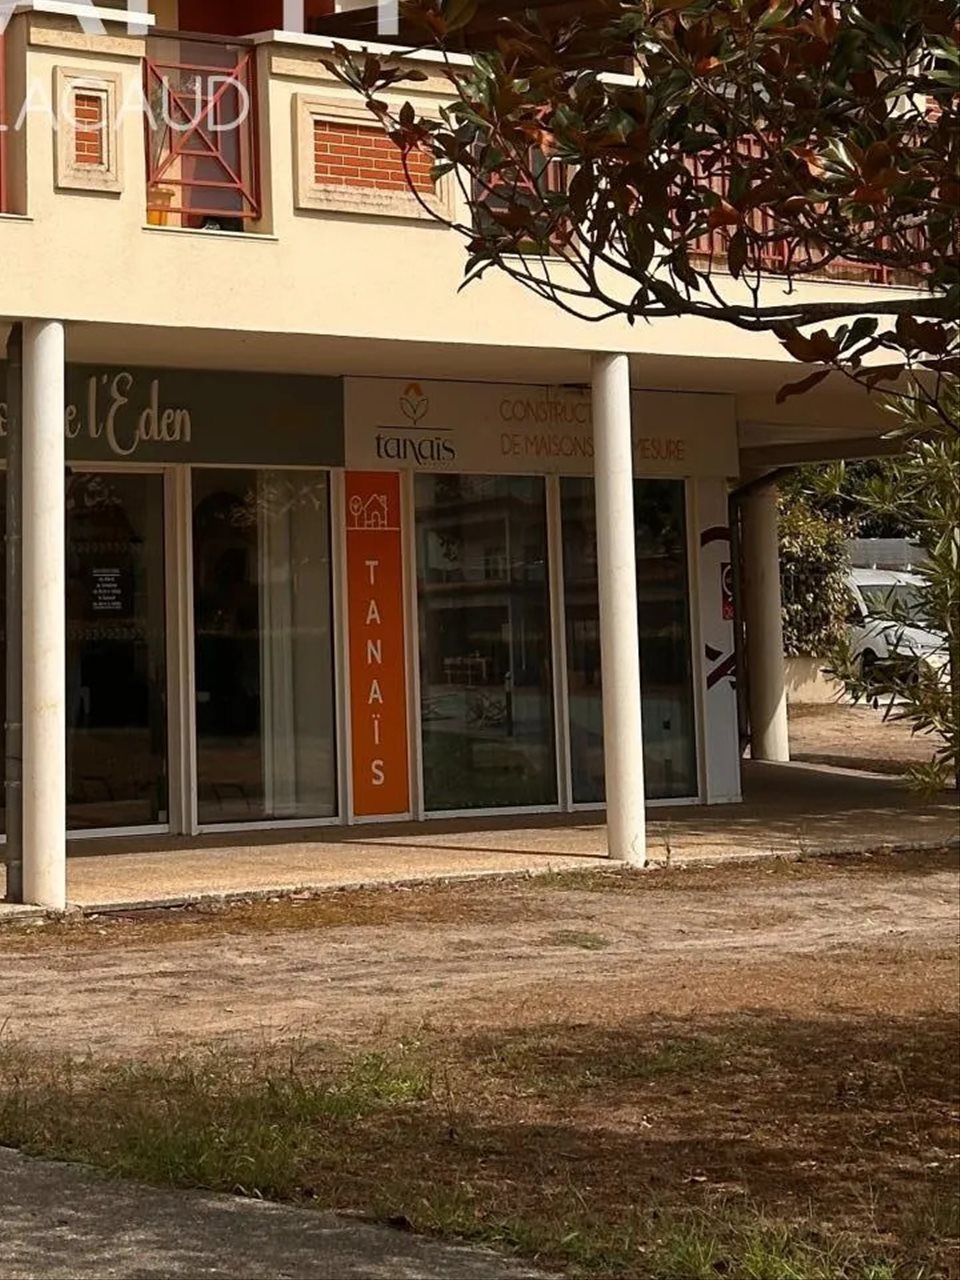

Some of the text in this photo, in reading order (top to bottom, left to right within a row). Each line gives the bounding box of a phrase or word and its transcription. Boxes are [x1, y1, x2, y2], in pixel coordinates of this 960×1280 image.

[64, 403, 81, 438] e
[87, 371, 191, 456] l'Eden
[499, 399, 594, 424] CONSTRUCT
[500, 433, 522, 456] DE
[365, 560, 385, 786] TANAÏS
